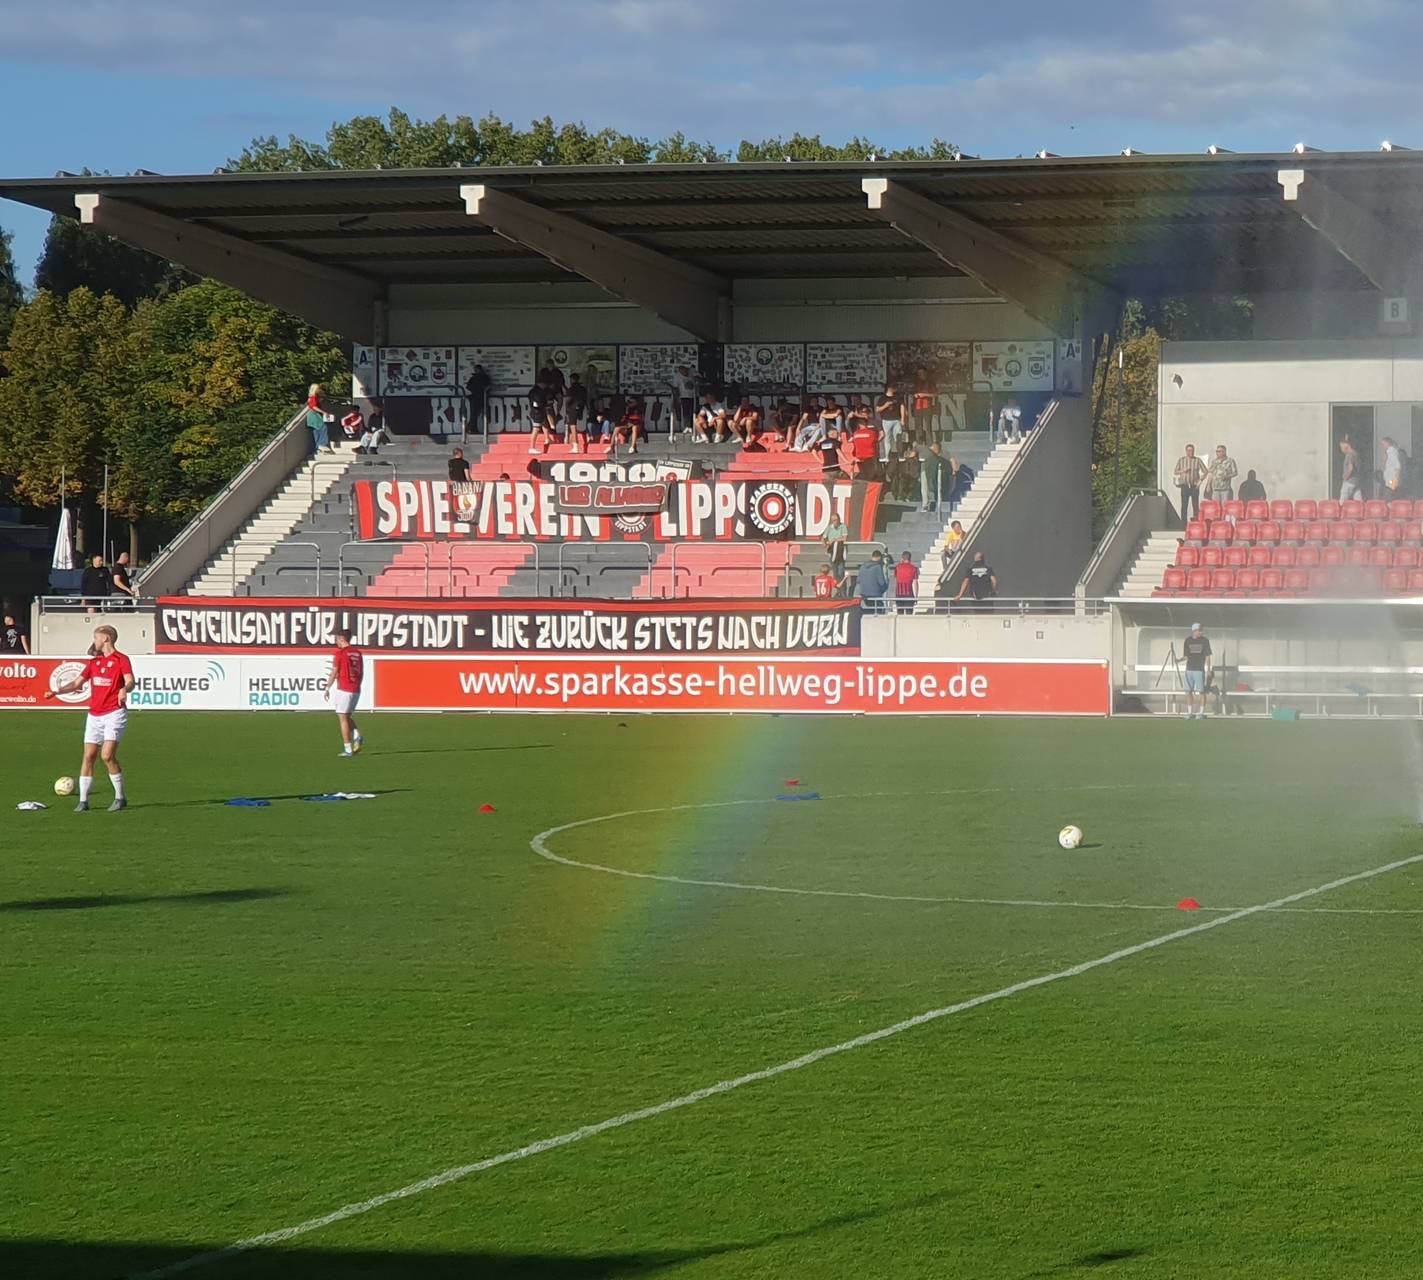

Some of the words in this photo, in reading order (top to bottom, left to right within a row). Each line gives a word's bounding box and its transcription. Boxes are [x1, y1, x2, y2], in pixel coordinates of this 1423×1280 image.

[816, 583, 827, 595] 16
[162, 609, 286, 645] GEMEINSAM
[290, 606, 335, 645] FÜR
[342, 612, 469, 648] LIPPSTADT
[491, 614, 529, 649] NIE
[535, 610, 628, 650] ZURÜCK
[634, 616, 714, 650] STETS
[718, 616, 780, 650] NACH
[785, 612, 850, 649] VORN
[133, 677, 210, 691] HELLWEG
[249, 677, 328, 691] HELLWEG
[459, 666, 989, 703] www.sparkasse-hellweg-lippe.de
[130, 692, 182, 705] RADIO
[249, 693, 299, 706] RADIO
